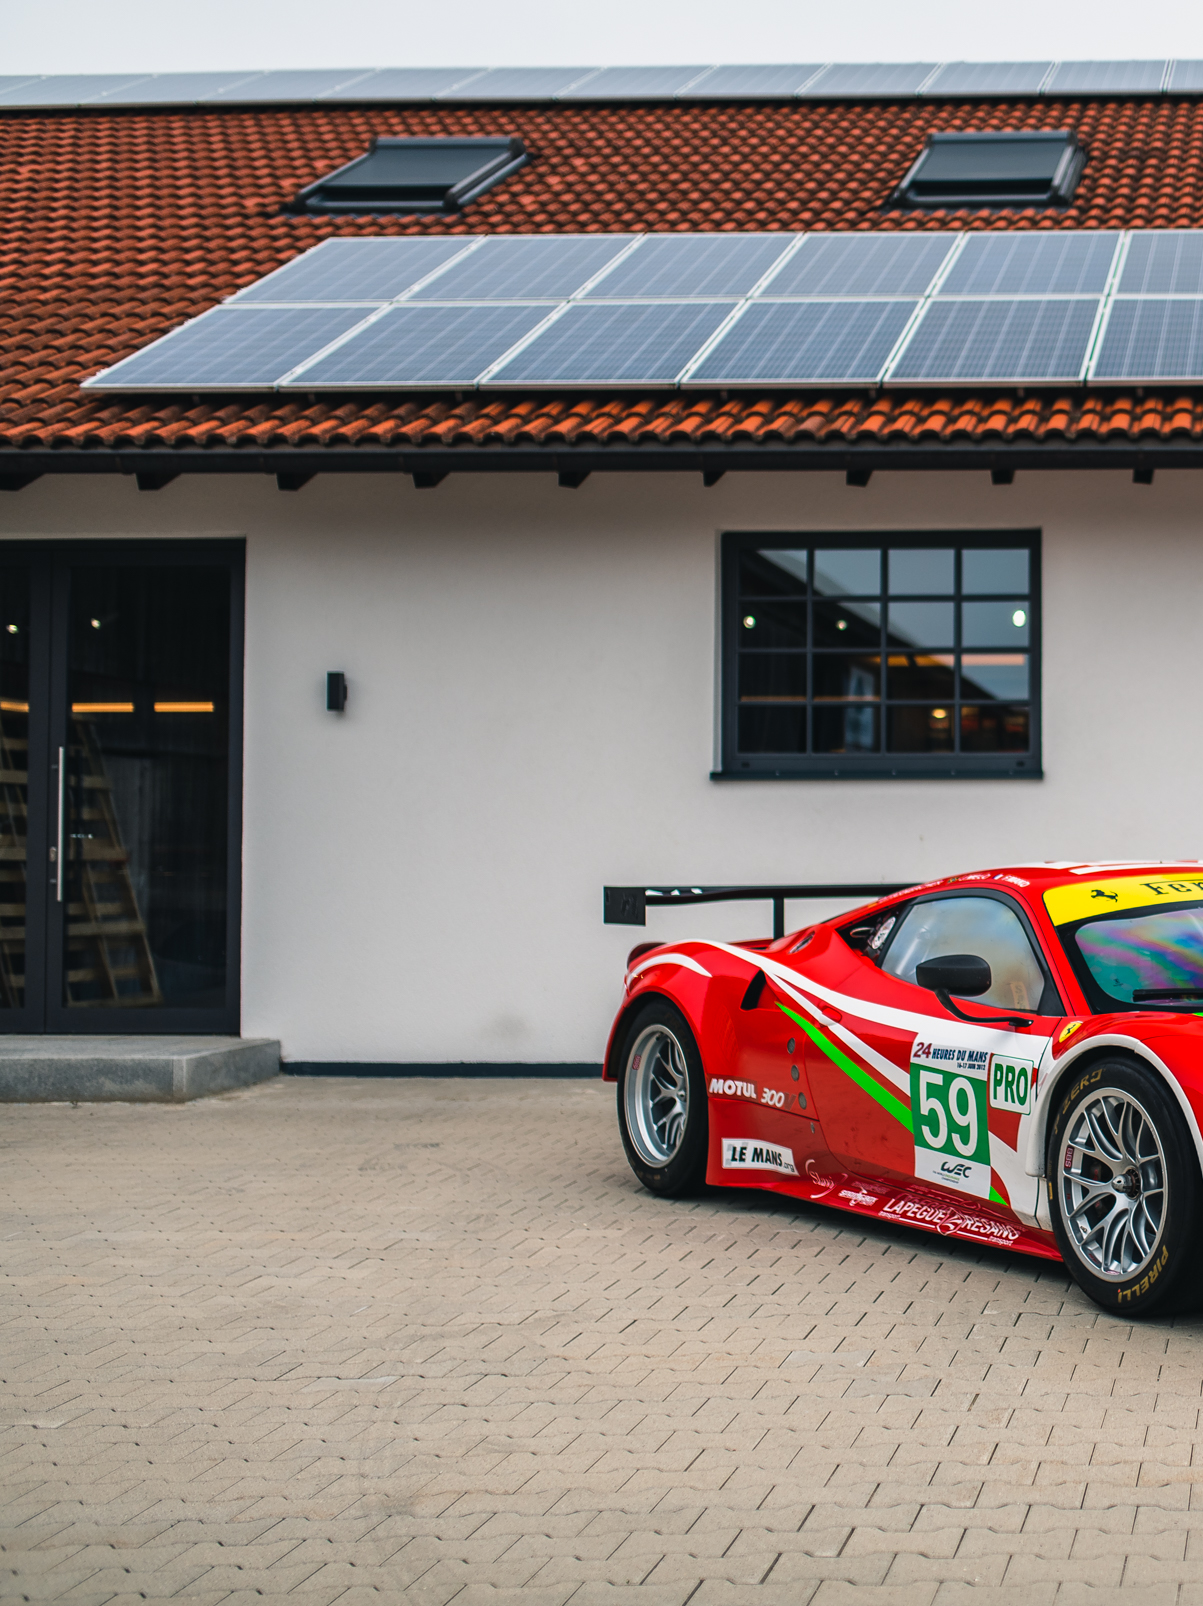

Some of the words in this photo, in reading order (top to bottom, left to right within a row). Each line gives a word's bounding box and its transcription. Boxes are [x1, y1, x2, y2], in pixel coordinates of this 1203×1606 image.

[913, 1042, 932, 1058] 24
[931, 1048, 956, 1060] HEURES
[956, 1050, 965, 1061] DU
[966, 1051, 988, 1063] MANS
[709, 1078, 757, 1099] MOTUL
[993, 1063, 1029, 1106] PRO
[919, 1070, 978, 1156] 59
[731, 1146, 747, 1162] LE
[940, 1161, 972, 1178] WEC
[882, 1199, 946, 1223] LAPEGUE
[961, 1215, 1020, 1241] RESANO
